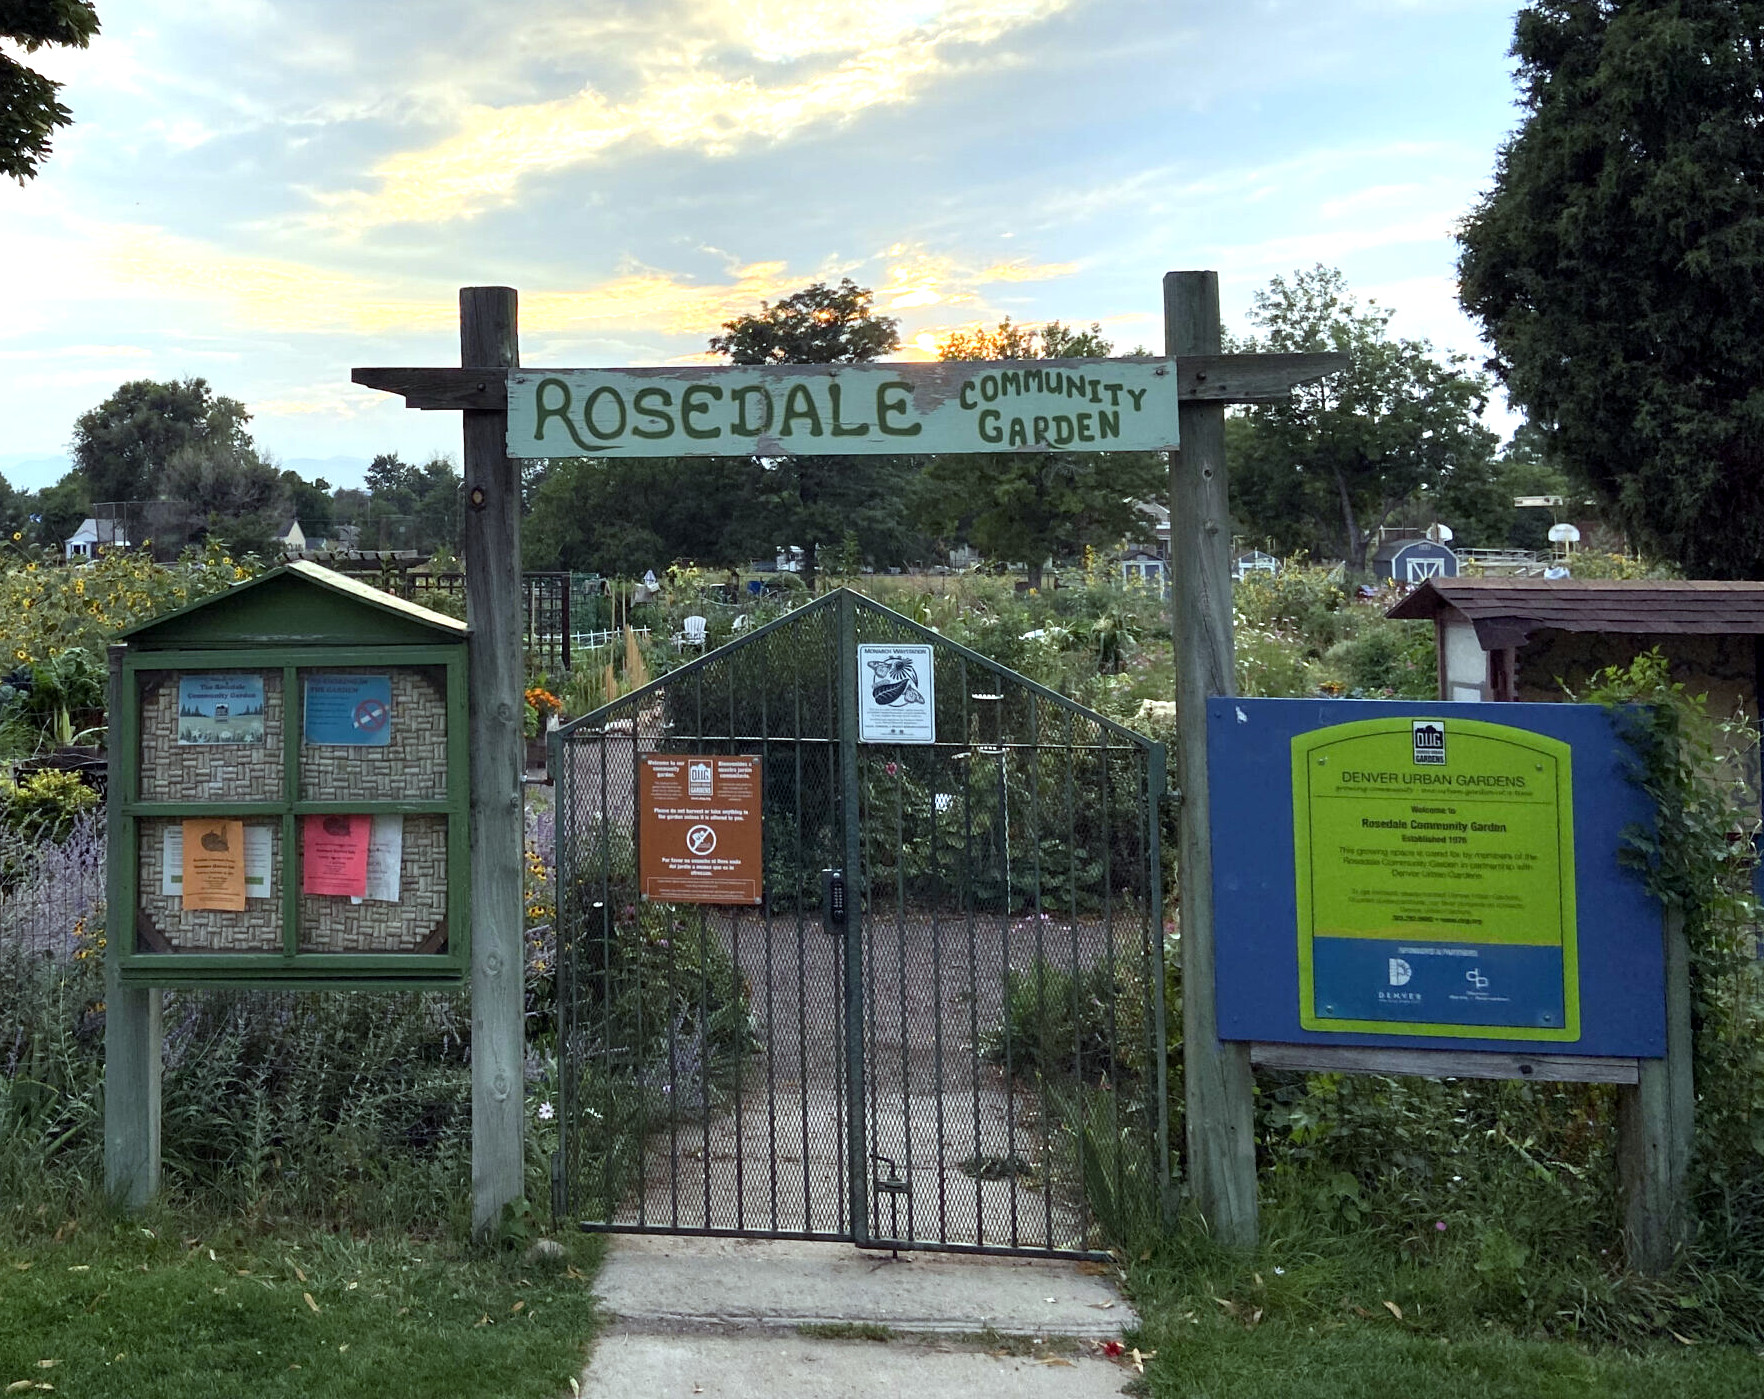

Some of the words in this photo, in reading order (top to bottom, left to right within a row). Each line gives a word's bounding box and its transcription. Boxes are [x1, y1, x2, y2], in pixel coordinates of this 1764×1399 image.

[960, 369, 1147, 411] COMMUNITY
[533, 377, 922, 451] ROSEDALE
[979, 409, 1120, 449] GARDEN
[1342, 770, 1399, 784] DENVER
[1402, 773, 1452, 786] URBAN
[1456, 774, 1526, 788] GARDENS
[1411, 806, 1447, 814] Welcome
[1361, 818, 1407, 829] Rosedale
[1410, 819, 1468, 832] Community
[1470, 821, 1507, 832] Garden
[1401, 834, 1447, 843] Established
